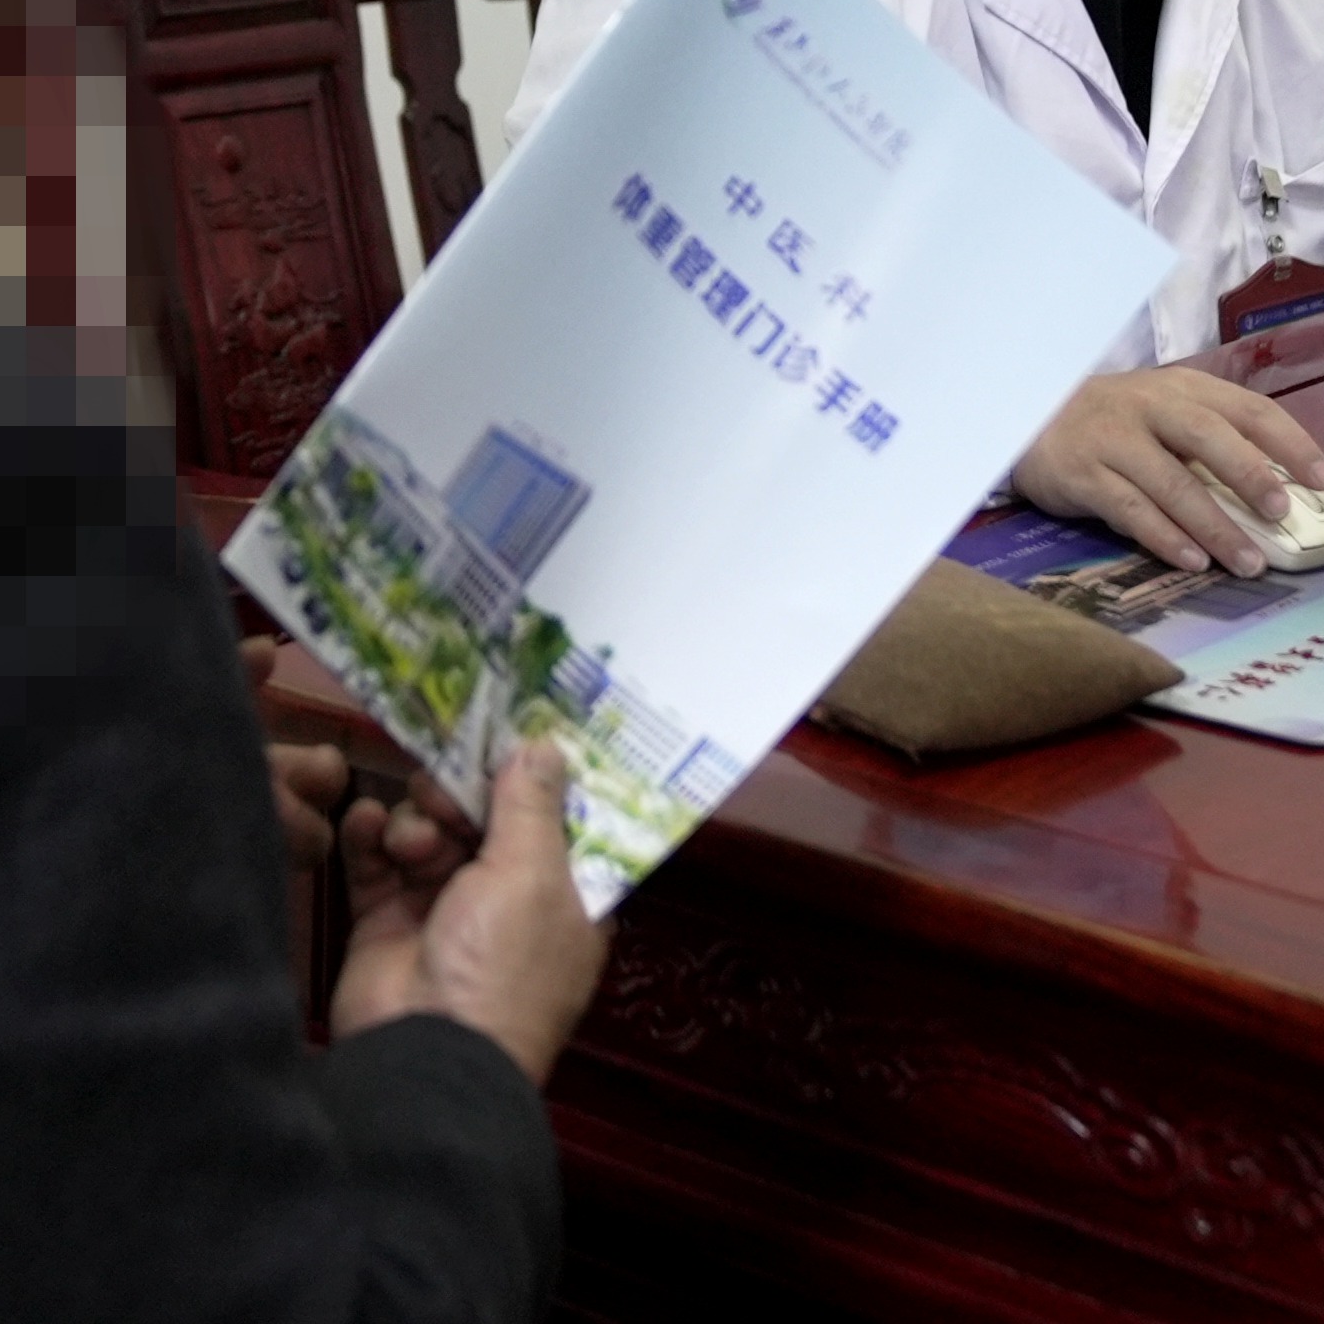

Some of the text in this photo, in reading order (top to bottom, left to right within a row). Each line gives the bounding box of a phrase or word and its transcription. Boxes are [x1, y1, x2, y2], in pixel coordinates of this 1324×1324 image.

[612, 172, 902, 455] 体重管理门诊手册
[723, 175, 874, 323] 中医科
